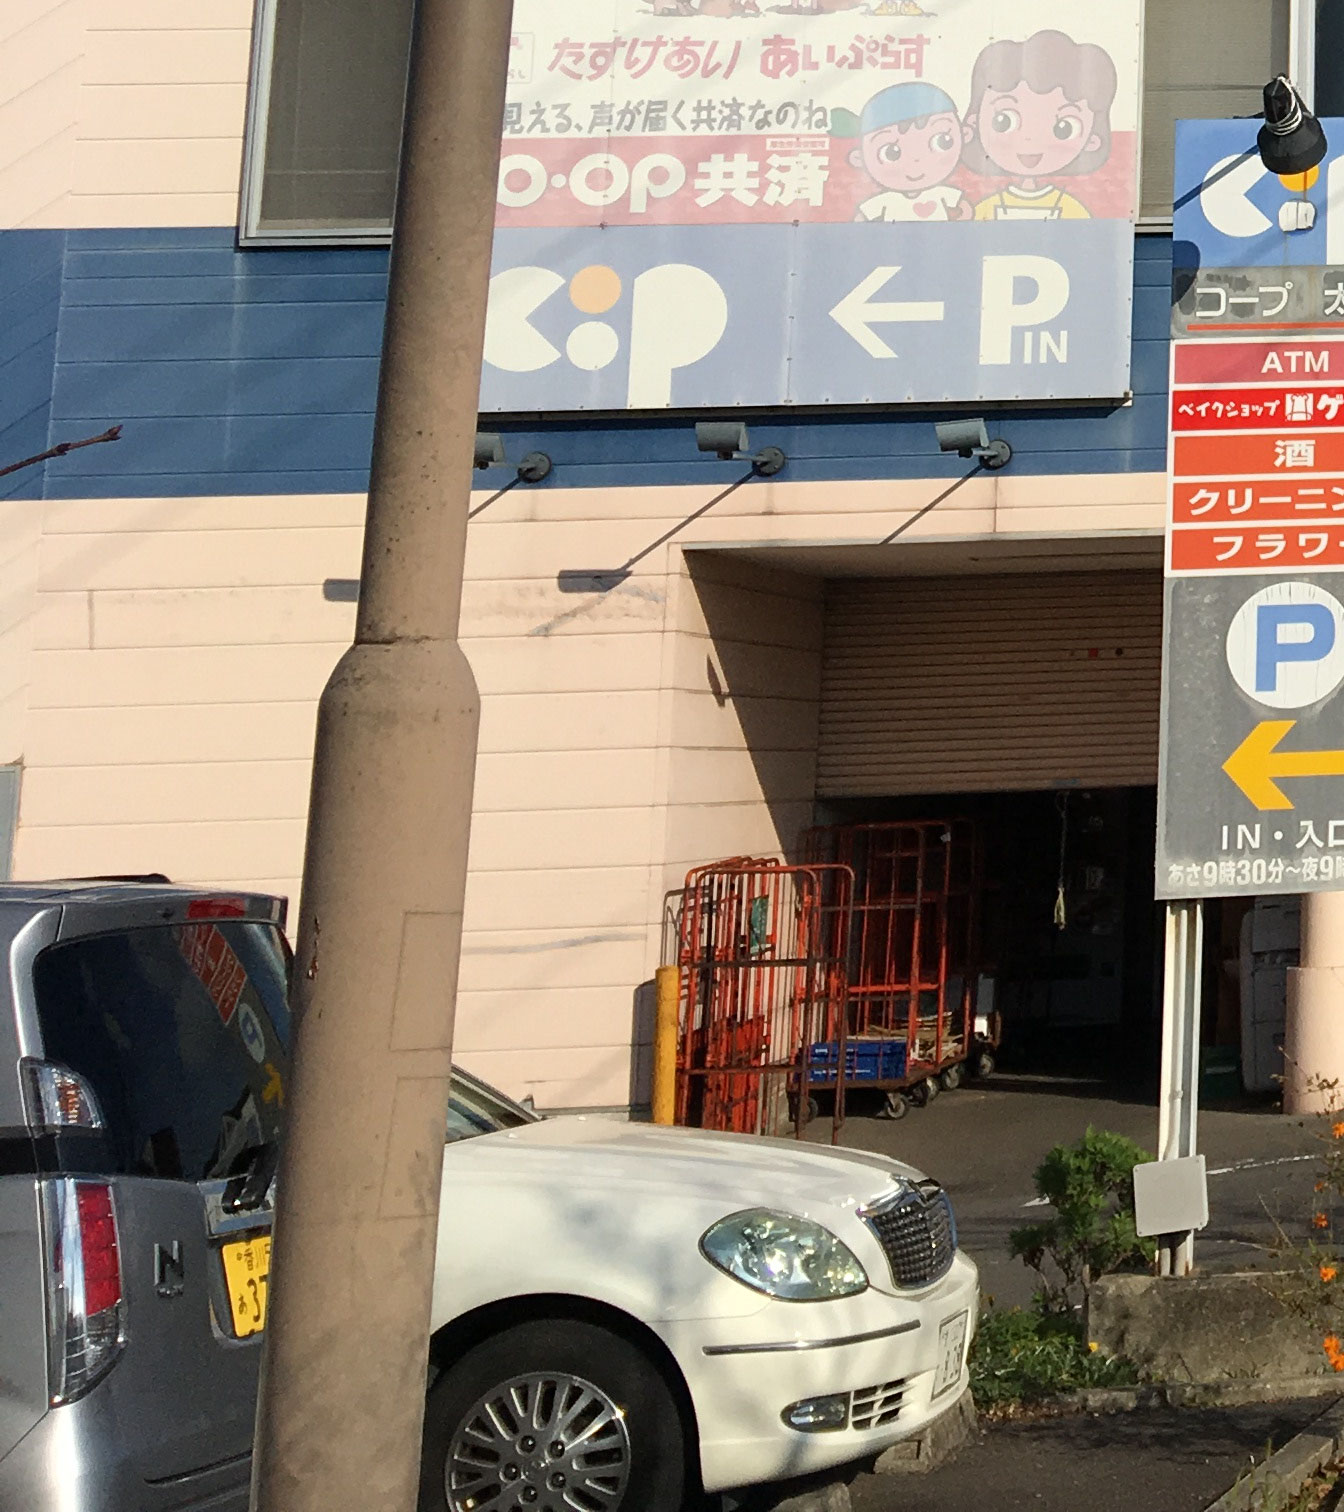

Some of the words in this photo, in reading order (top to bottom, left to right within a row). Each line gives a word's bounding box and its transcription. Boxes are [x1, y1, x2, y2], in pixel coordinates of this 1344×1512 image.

[547, 35, 741, 80] たすけあい
[759, 33, 931, 79] あいぷらす
[694, 152, 830, 208] 共済
[979, 255, 1070, 365] P
[1195, 281, 1293, 318] コープ
[1022, 330, 1069, 364] IN
[1260, 350, 1330, 375] ATM
[1178, 400, 1281, 419] ベイクショップ
[1273, 439, 1317, 469] 酒
[1255, 603, 1336, 693] P
